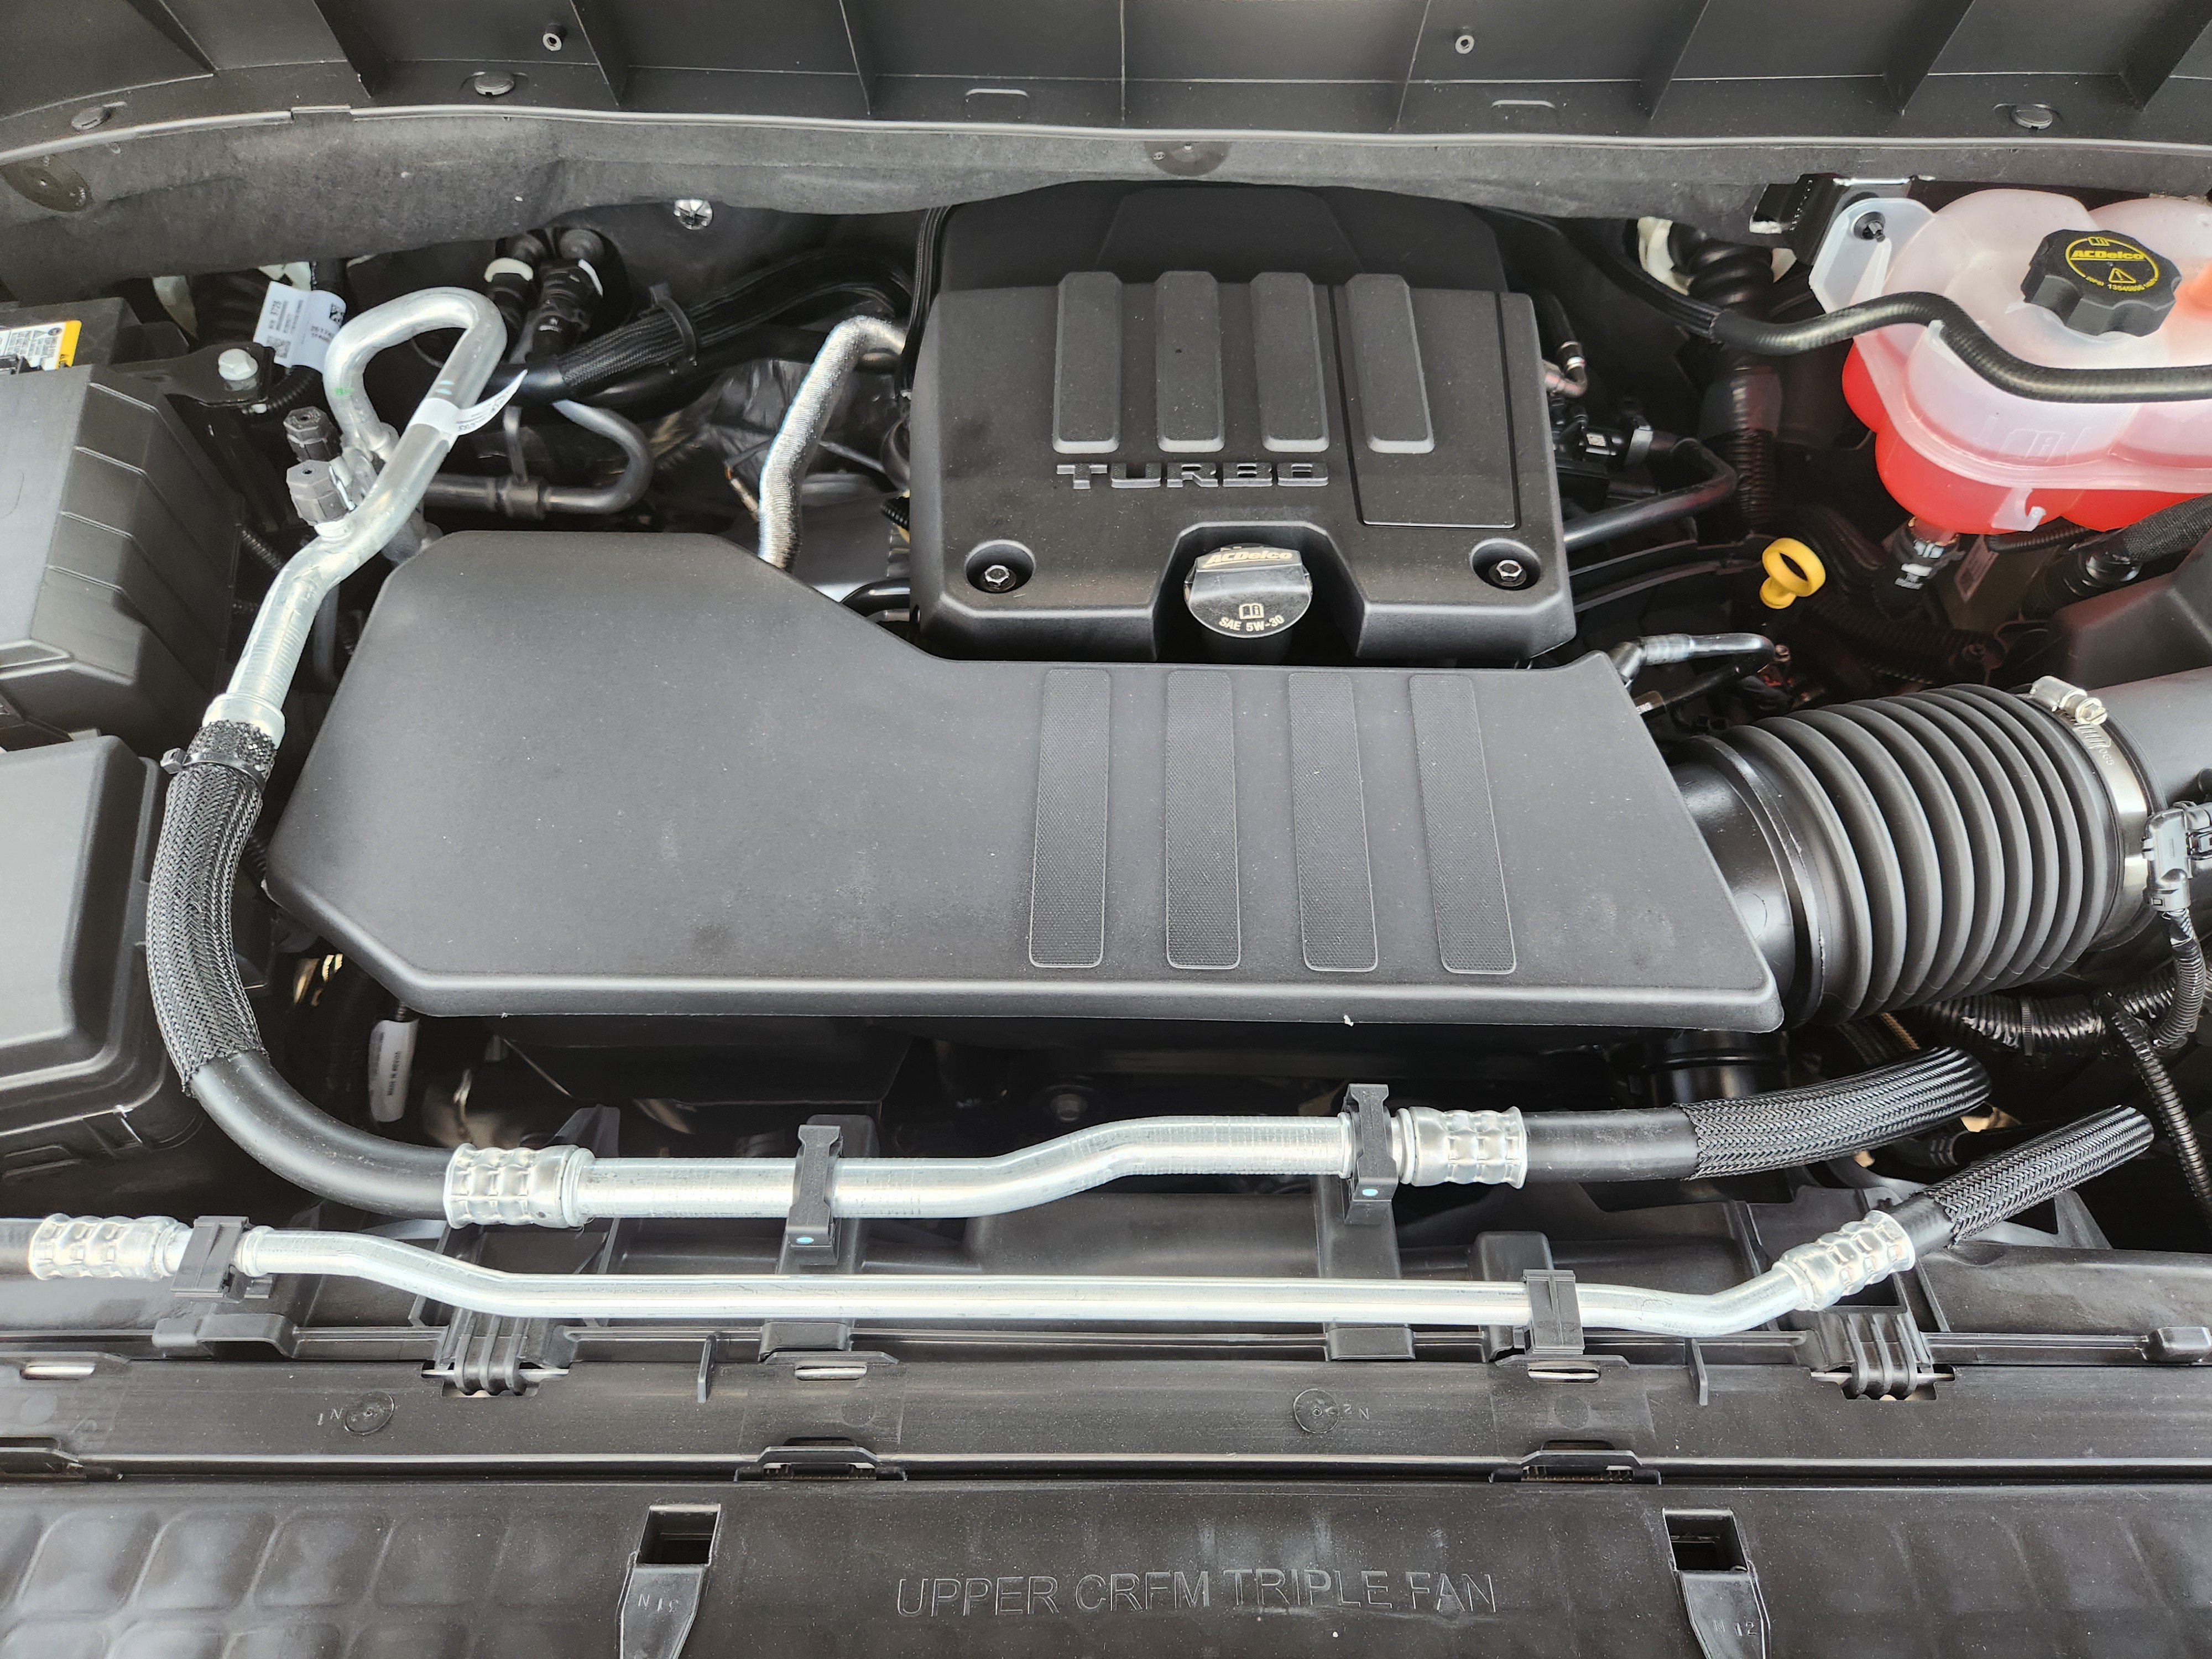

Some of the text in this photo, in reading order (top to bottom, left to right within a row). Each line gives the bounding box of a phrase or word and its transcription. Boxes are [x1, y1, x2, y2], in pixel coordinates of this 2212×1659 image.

[2071, 250, 2145, 260] ACDelco
[1056, 462, 1328, 489] TURBO
[1206, 550, 1293, 565] ACDelco
[1218, 614, 1285, 632] SAE 5W-30
[896, 1568, 1496, 1618] UPPER CRFM TRIPLE FAN
